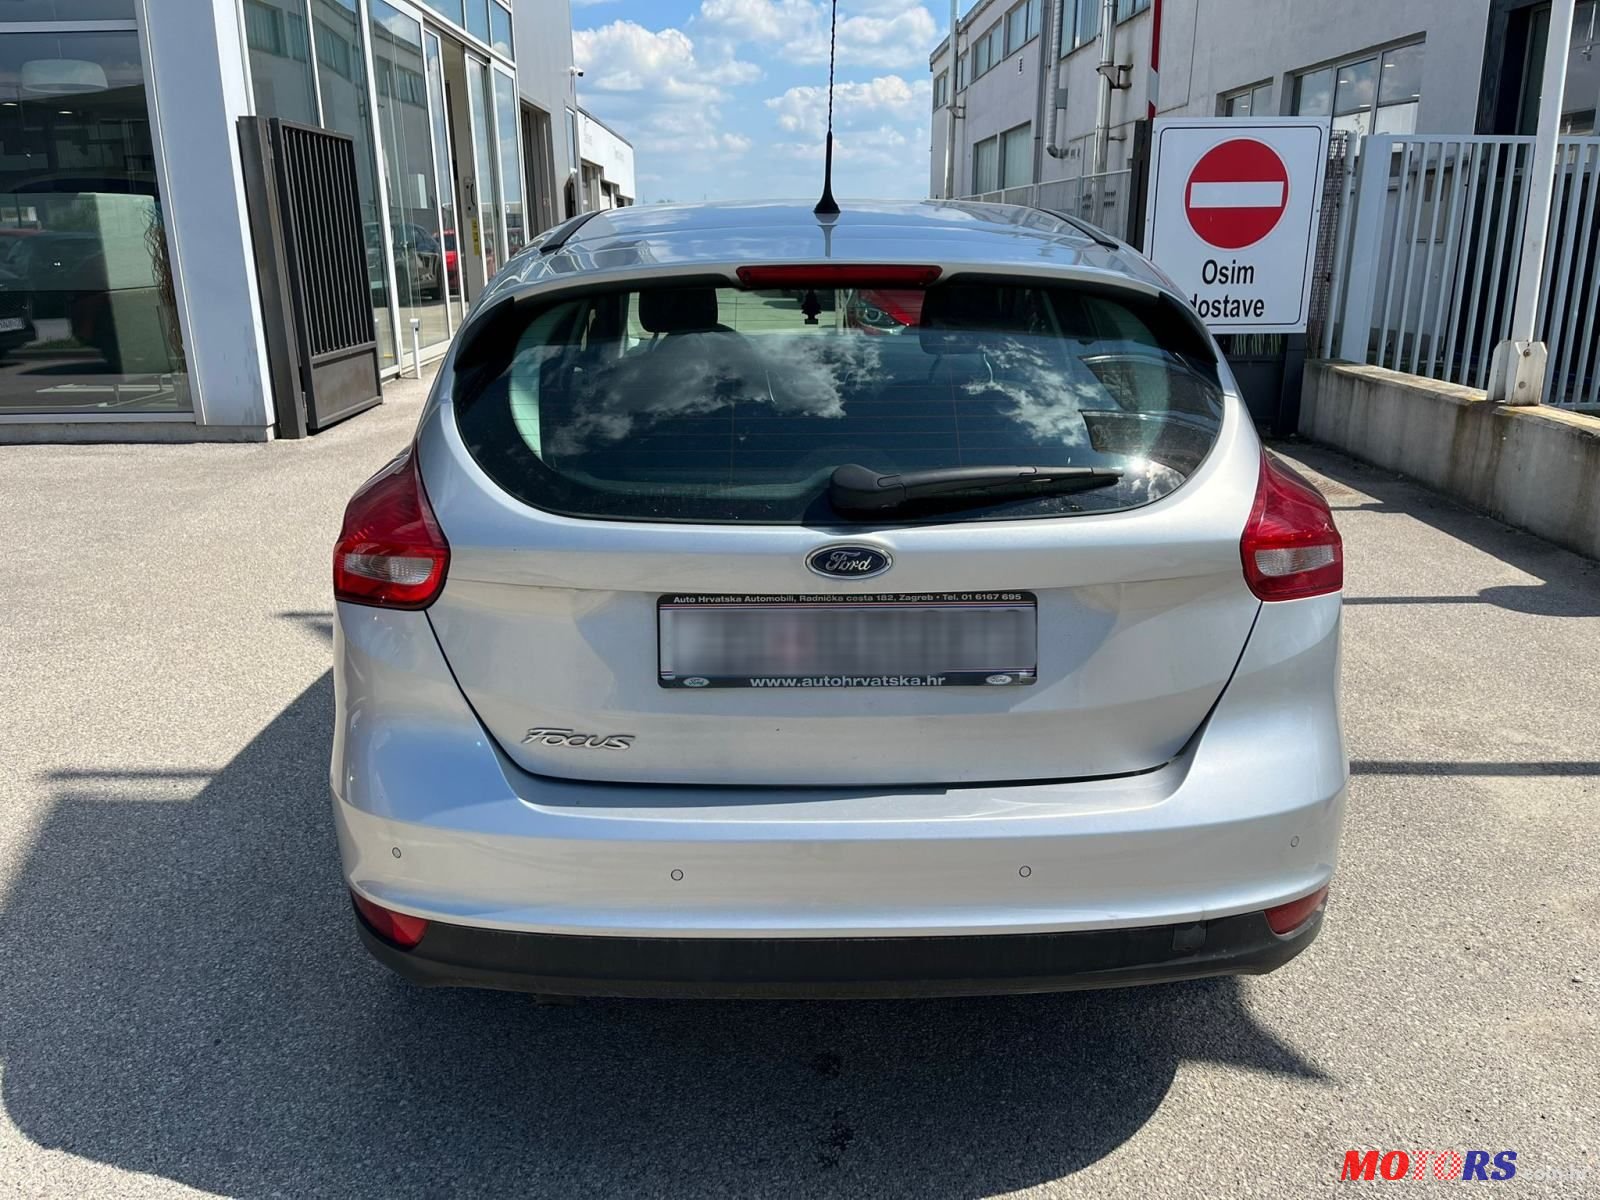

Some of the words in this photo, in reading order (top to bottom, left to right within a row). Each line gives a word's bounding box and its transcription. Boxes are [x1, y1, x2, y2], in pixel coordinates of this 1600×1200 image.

[1202, 259, 1255, 285] Osim
[825, 551, 872, 571] Ford
[698, 595, 742, 603] Hrvatska
[744, 594, 797, 604] Automobili,
[876, 594, 896, 603] 182,
[899, 594, 934, 602] Zagreb
[942, 593, 959, 601] Tel.
[961, 593, 972, 601] 01
[975, 593, 999, 601] 6167
[750, 675, 946, 687] www.autohrvatska.hr
